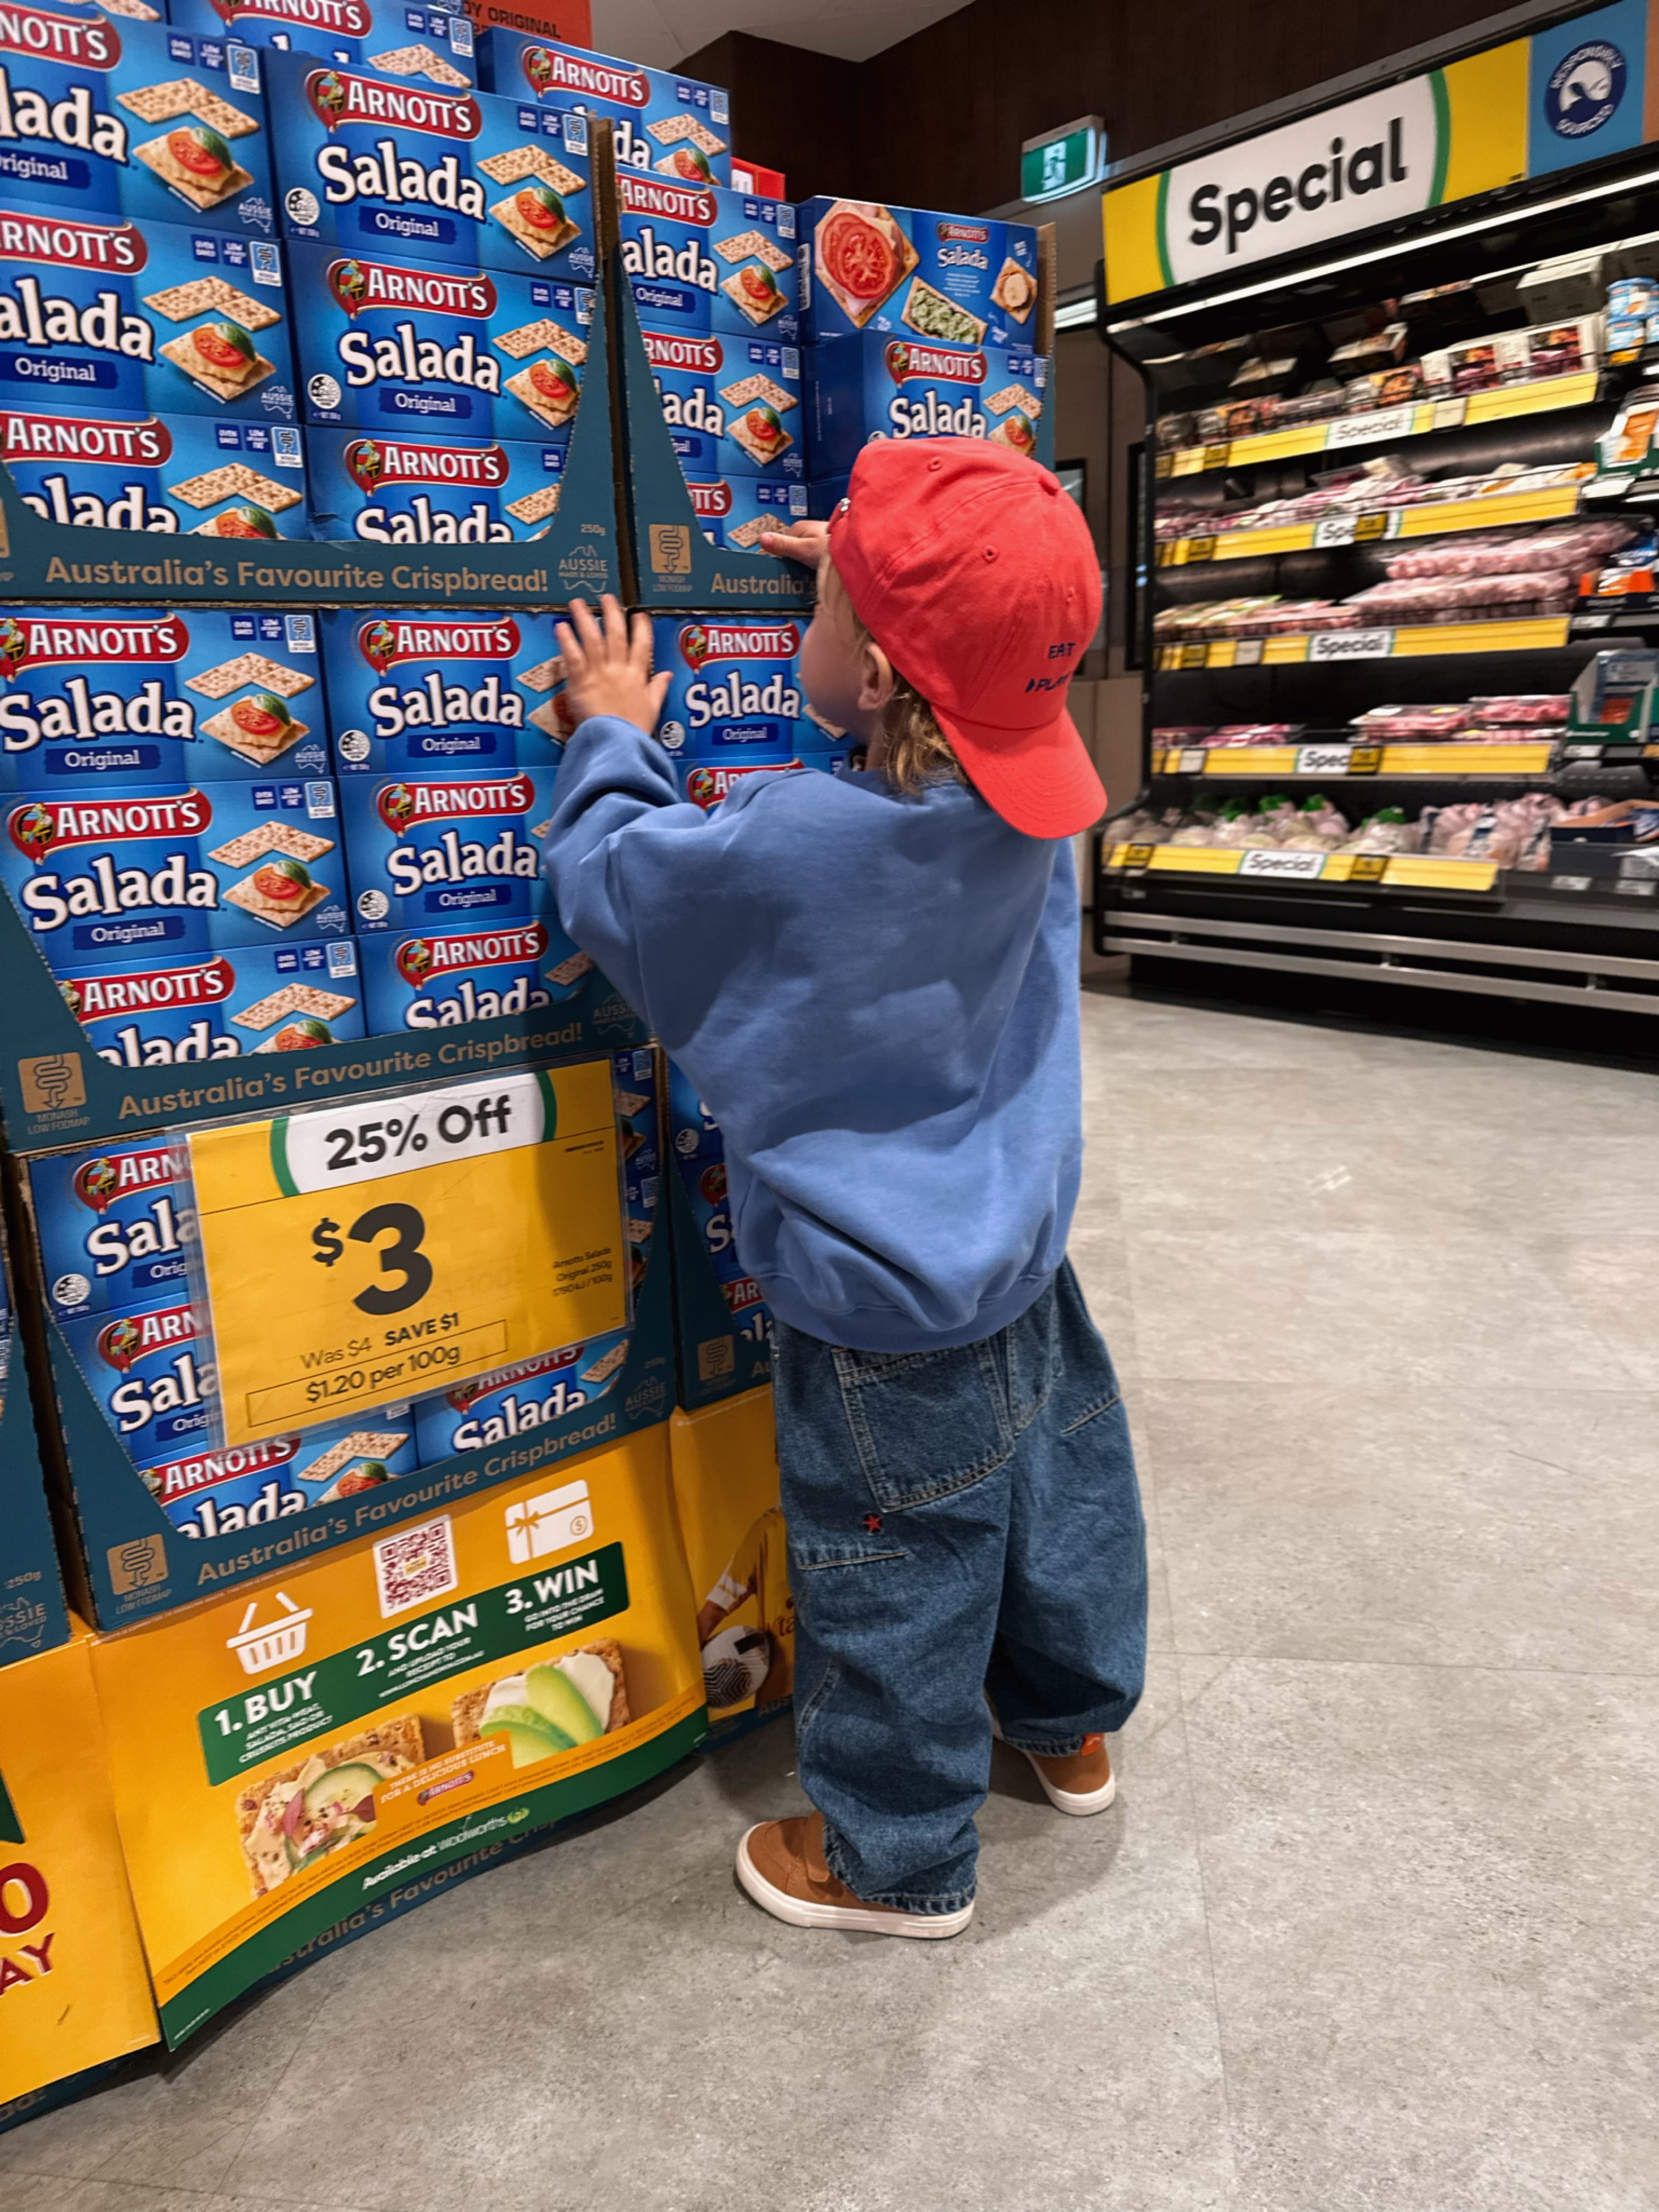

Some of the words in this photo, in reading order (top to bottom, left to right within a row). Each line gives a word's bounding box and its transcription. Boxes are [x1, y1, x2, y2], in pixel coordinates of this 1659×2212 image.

[488, 7, 560, 38] ORIGINAL
[551, 57, 644, 101] ARNOTT'S
[348, 81, 471, 132] ARNOTT'S
[318, 141, 485, 219] Salada
[1189, 118, 1408, 254] Special
[375, 213, 438, 236] Original
[947, 225, 988, 242] ARNOTT'S
[938, 245, 988, 270] Salada
[368, 269, 487, 311] ARNOTT'S
[635, 288, 683, 307] Original
[15, 358, 95, 382] Original
[339, 324, 499, 393] Salada
[909, 348, 981, 379] ARNOTT'S
[394, 393, 455, 413] Original
[890, 391, 987, 439] Salada
[8, 418, 160, 458] ARNOTT'S
[1336, 414, 1403, 440] Special
[383, 446, 500, 480] ARNOTT'S
[580, 524, 606, 536] 250g
[46, 557, 229, 586] Australia's
[238, 561, 384, 589] Favourite
[392, 566, 548, 596] Crispbread!
[558, 559, 608, 572] AUSSIE
[711, 574, 816, 594] Australia's
[30, 624, 177, 656] ARNOTT'S
[397, 625, 512, 653] ARNOTT'S
[708, 630, 794, 654] ARNOTT'S
[1048, 642, 1076, 659] EAT
[1317, 634, 1385, 656] Special
[0, 678, 194, 751] Salada
[369, 673, 523, 737] Salada
[686, 672, 800, 727] Salada
[422, 737, 481, 754] Original
[723, 728, 767, 741] Original
[65, 752, 140, 769] Original
[415, 783, 526, 815] ARNOTT'S
[57, 800, 201, 838] ARNOTT'S
[388, 831, 538, 895] Salada
[1249, 854, 1315, 874] Special
[23, 856, 217, 930] Salada
[439, 889, 496, 908] Original
[91, 922, 165, 944] Original
[432, 933, 540, 968] ARNOTT'S
[83, 968, 224, 1012] ARNOTT'S
[119, 1073, 286, 1119] Australia's
[295, 1050, 431, 1090] Favourite
[438, 1022, 583, 1064] Crispbread!
[27, 1122, 52, 1135] LOW
[52, 1116, 91, 1131] FODMAP
[37, 1109, 78, 1122] MONASH
[325, 1113, 428, 1170] 25%
[437, 1095, 512, 1144] Off
[301, 1347, 343, 1369] Was
[347, 1336, 372, 1357] $4
[384, 1318, 436, 1346] SAVE
[441, 1312, 459, 1334] $1
[306, 1370, 365, 1404] $1.20
[370, 1361, 404, 1389] per
[409, 1344, 460, 1370] 100g
[454, 1381, 587, 1451] Salada
[165, 1438, 291, 1494] ARNOTT'S
[197, 1519, 348, 1585] Australia's
[356, 1471, 478, 1528] Favourite
[485, 1412, 616, 1477] Crispbread!
[6, 1571, 42, 1589] 250g
[124, 1584, 161, 1602] MONASH
[505, 1587, 534, 1616] 3.
[534, 1559, 599, 1602] WIN
[116, 1599, 136, 1615] LOW
[136, 1589, 172, 1608] FODMAP
[356, 1649, 385, 1677] 2.
[387, 1603, 479, 1661] SCAN
[215, 1708, 244, 1736] 1.
[244, 1671, 317, 1724] BUY
[381, 1788, 402, 1804] FOR
[403, 1784, 412, 1793] A
[413, 1758, 468, 1788] DELICIOUS
[469, 1743, 506, 1764] LUNCH
[390, 1772, 418, 1791] THERE
[419, 1768, 428, 1776] IS
[428, 1761, 444, 1771] NO
[362, 1854, 419, 1891] Available
[268, 1904, 384, 1974] stralia's
